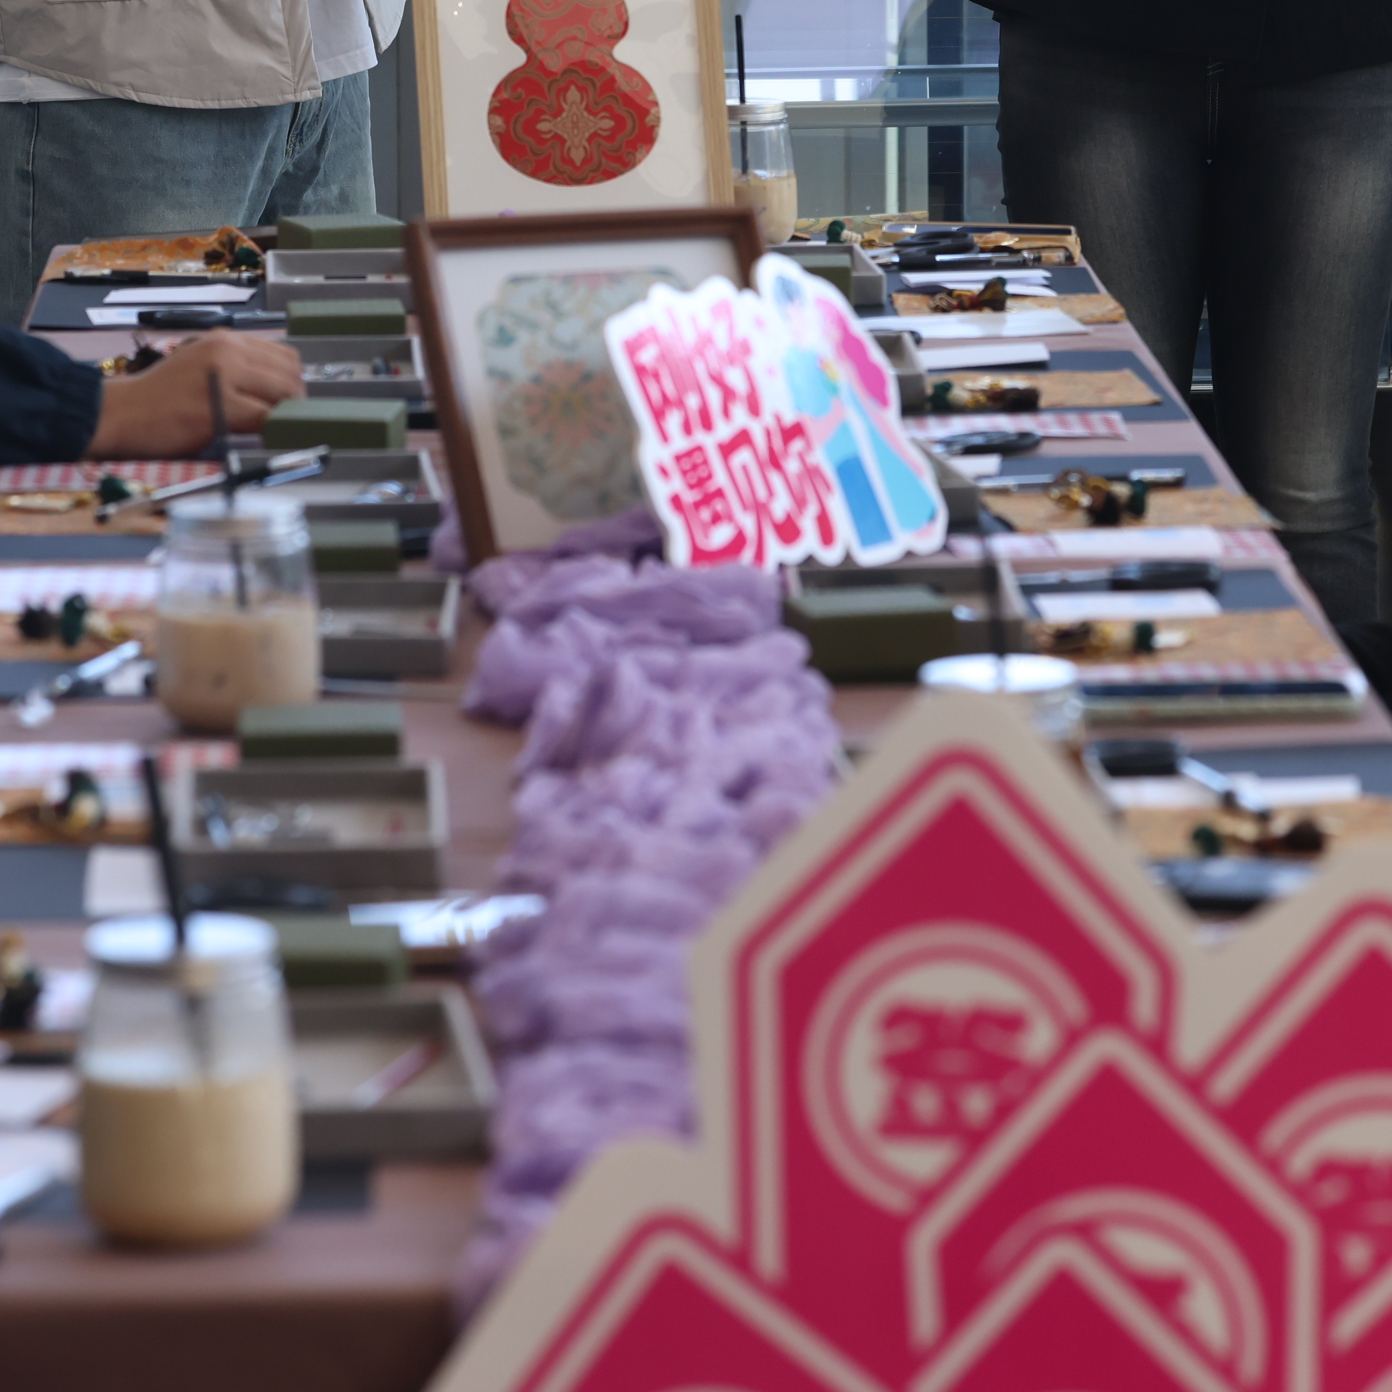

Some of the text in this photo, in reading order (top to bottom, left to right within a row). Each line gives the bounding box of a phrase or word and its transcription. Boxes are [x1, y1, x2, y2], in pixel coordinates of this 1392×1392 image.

[623, 298, 760, 445] 刚好
[656, 414, 834, 568] 遇见你
